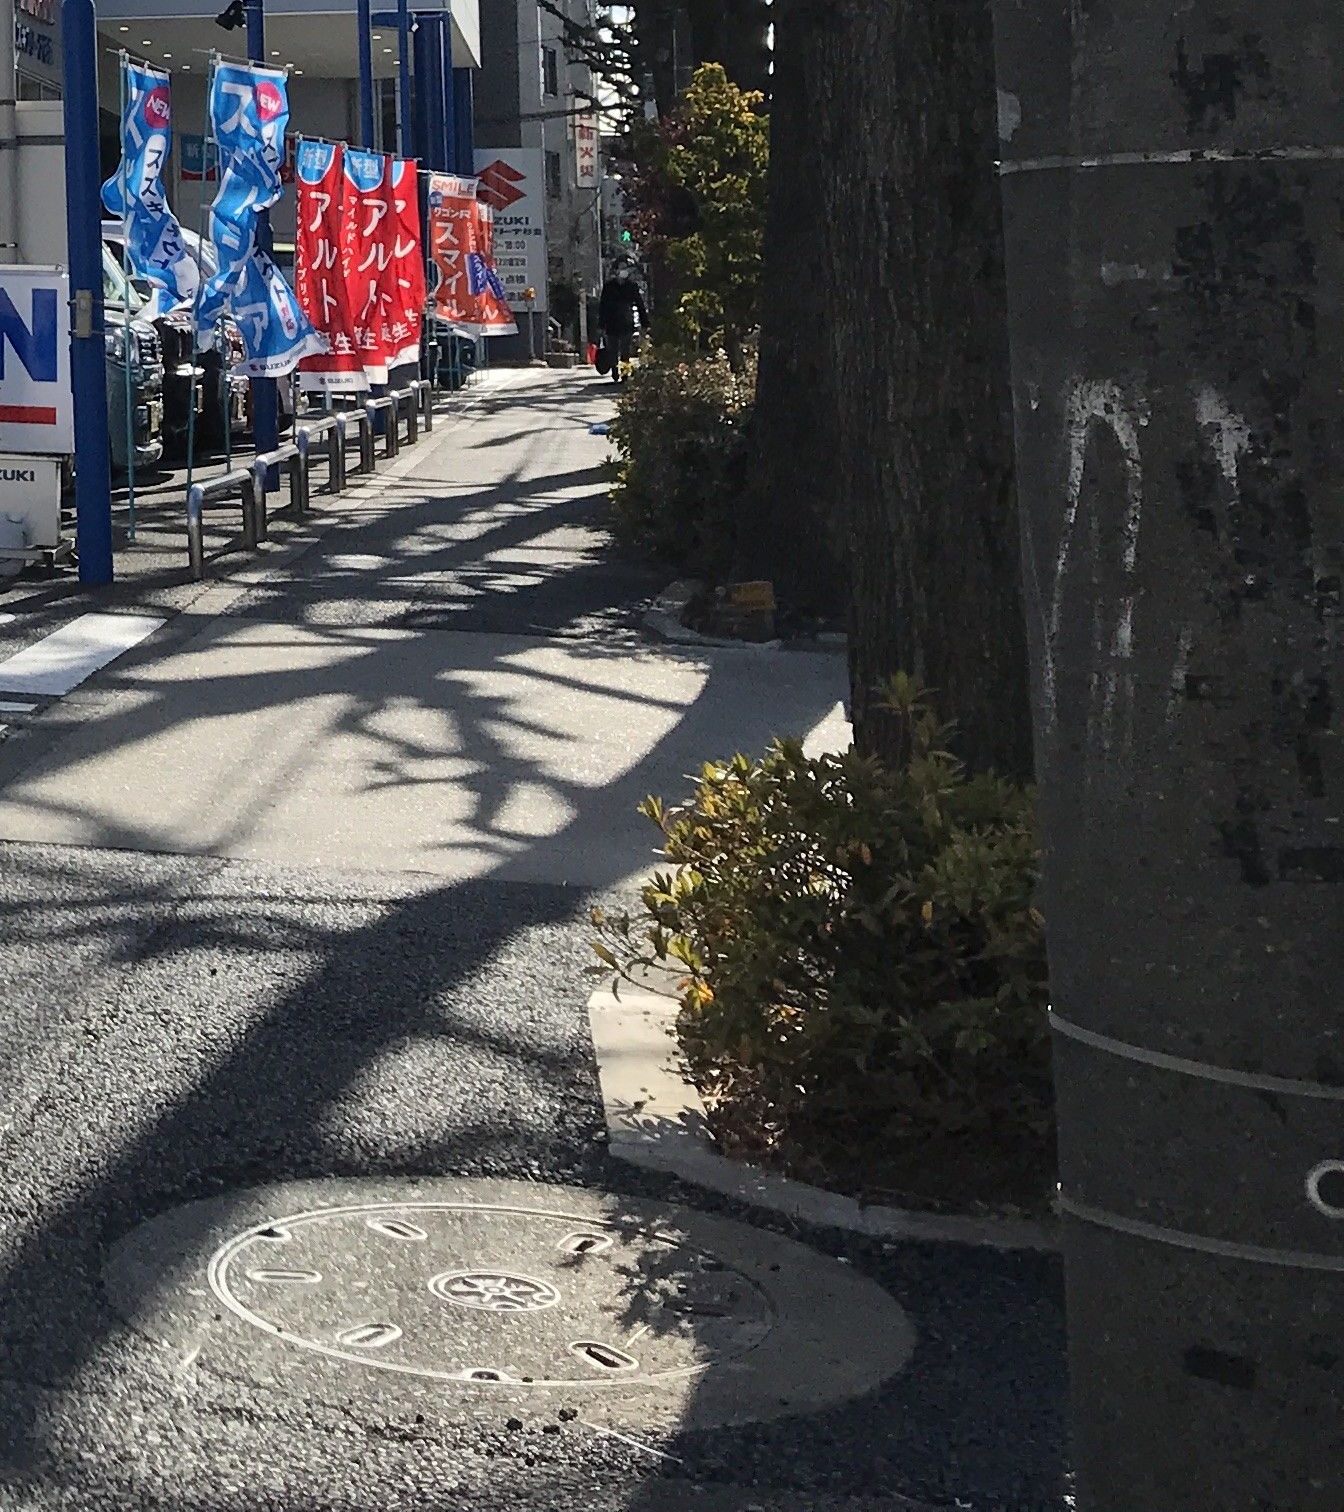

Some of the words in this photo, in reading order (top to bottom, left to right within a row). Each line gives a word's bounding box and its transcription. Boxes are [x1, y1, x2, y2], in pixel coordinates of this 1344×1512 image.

[257, 92, 280, 112] EW
[433, 179, 475, 197] SMILE
[309, 191, 338, 324] アルト
